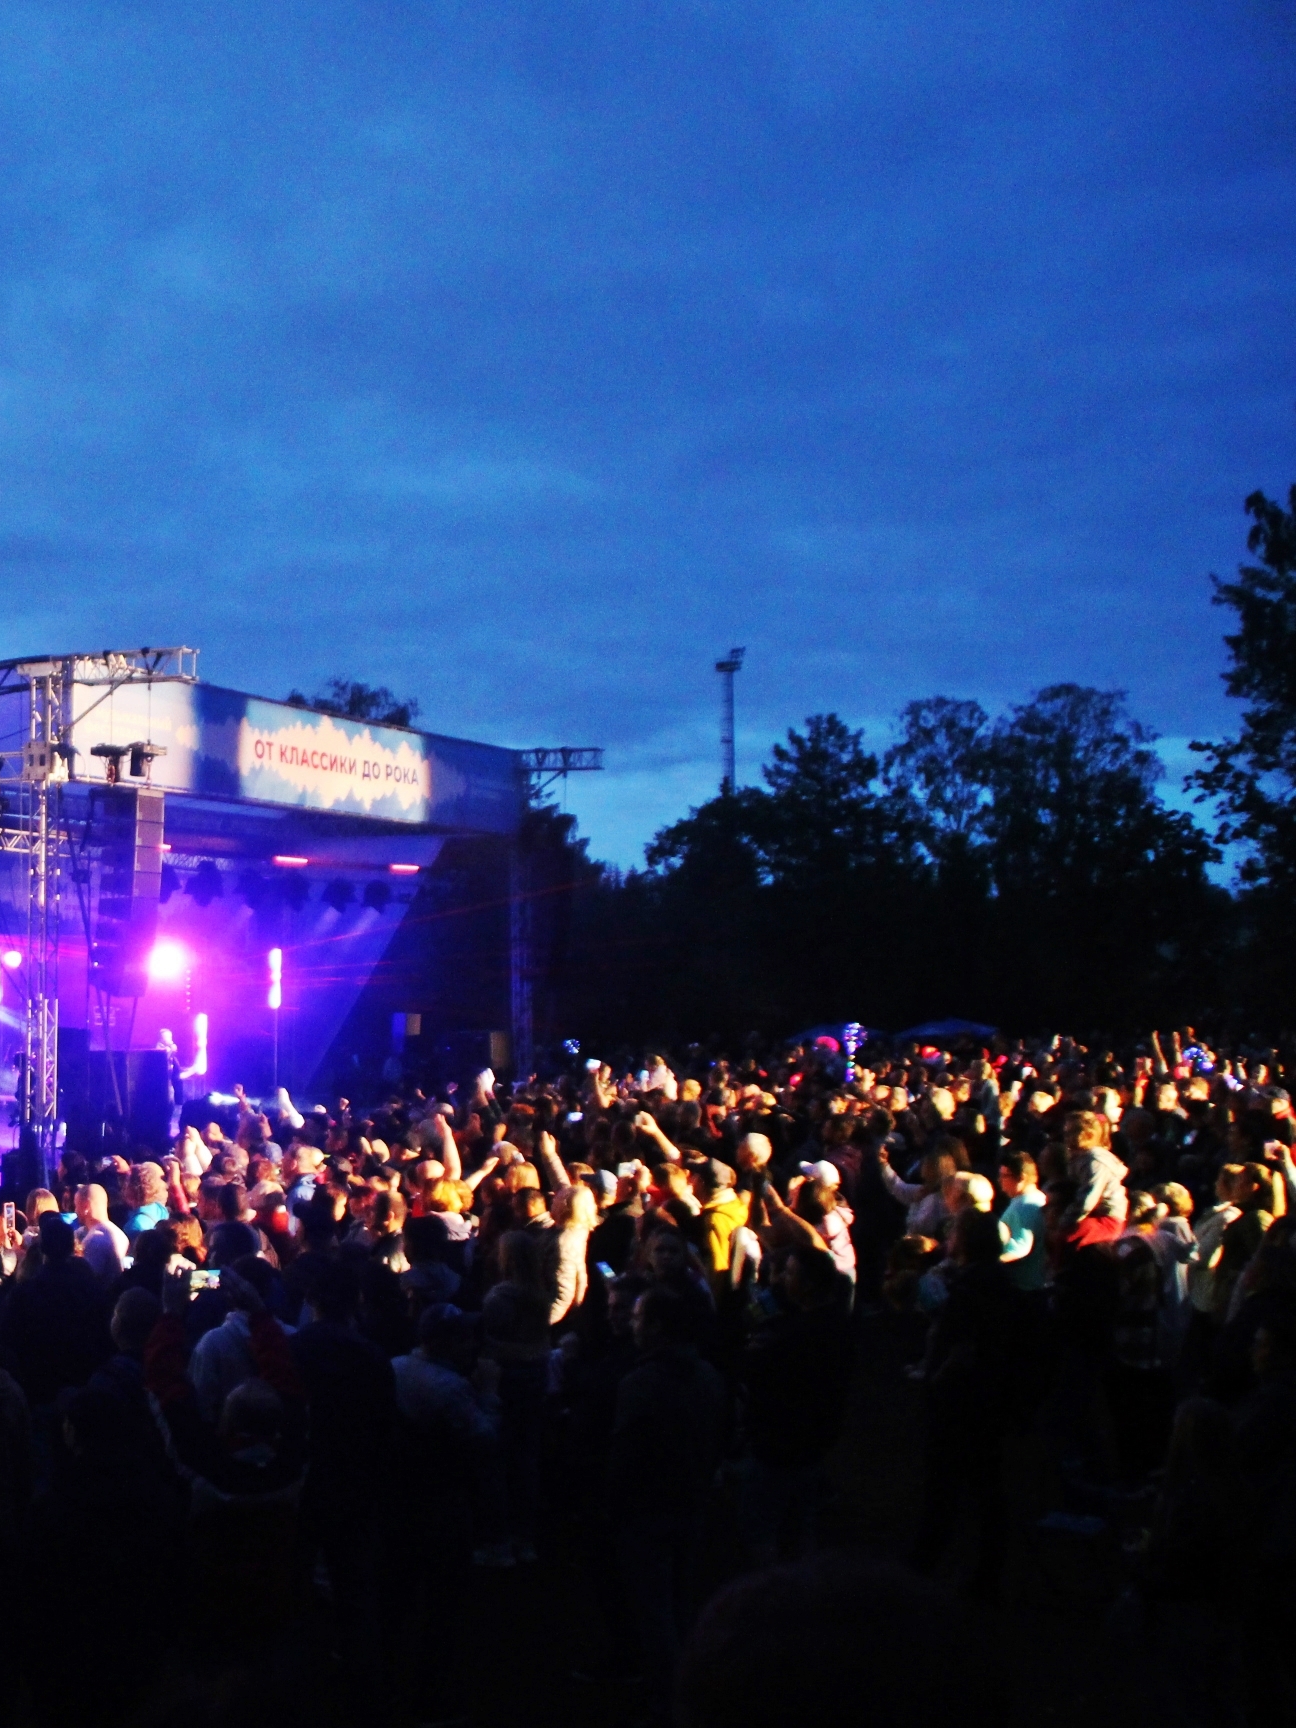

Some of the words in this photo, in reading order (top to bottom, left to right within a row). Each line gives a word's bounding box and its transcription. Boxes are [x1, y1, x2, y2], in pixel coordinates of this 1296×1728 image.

[254, 738, 273, 761] ОТ
[280, 743, 357, 776] КЛАССИКИ
[362, 760, 381, 784] ДО
[385, 762, 419, 787] РОКА
